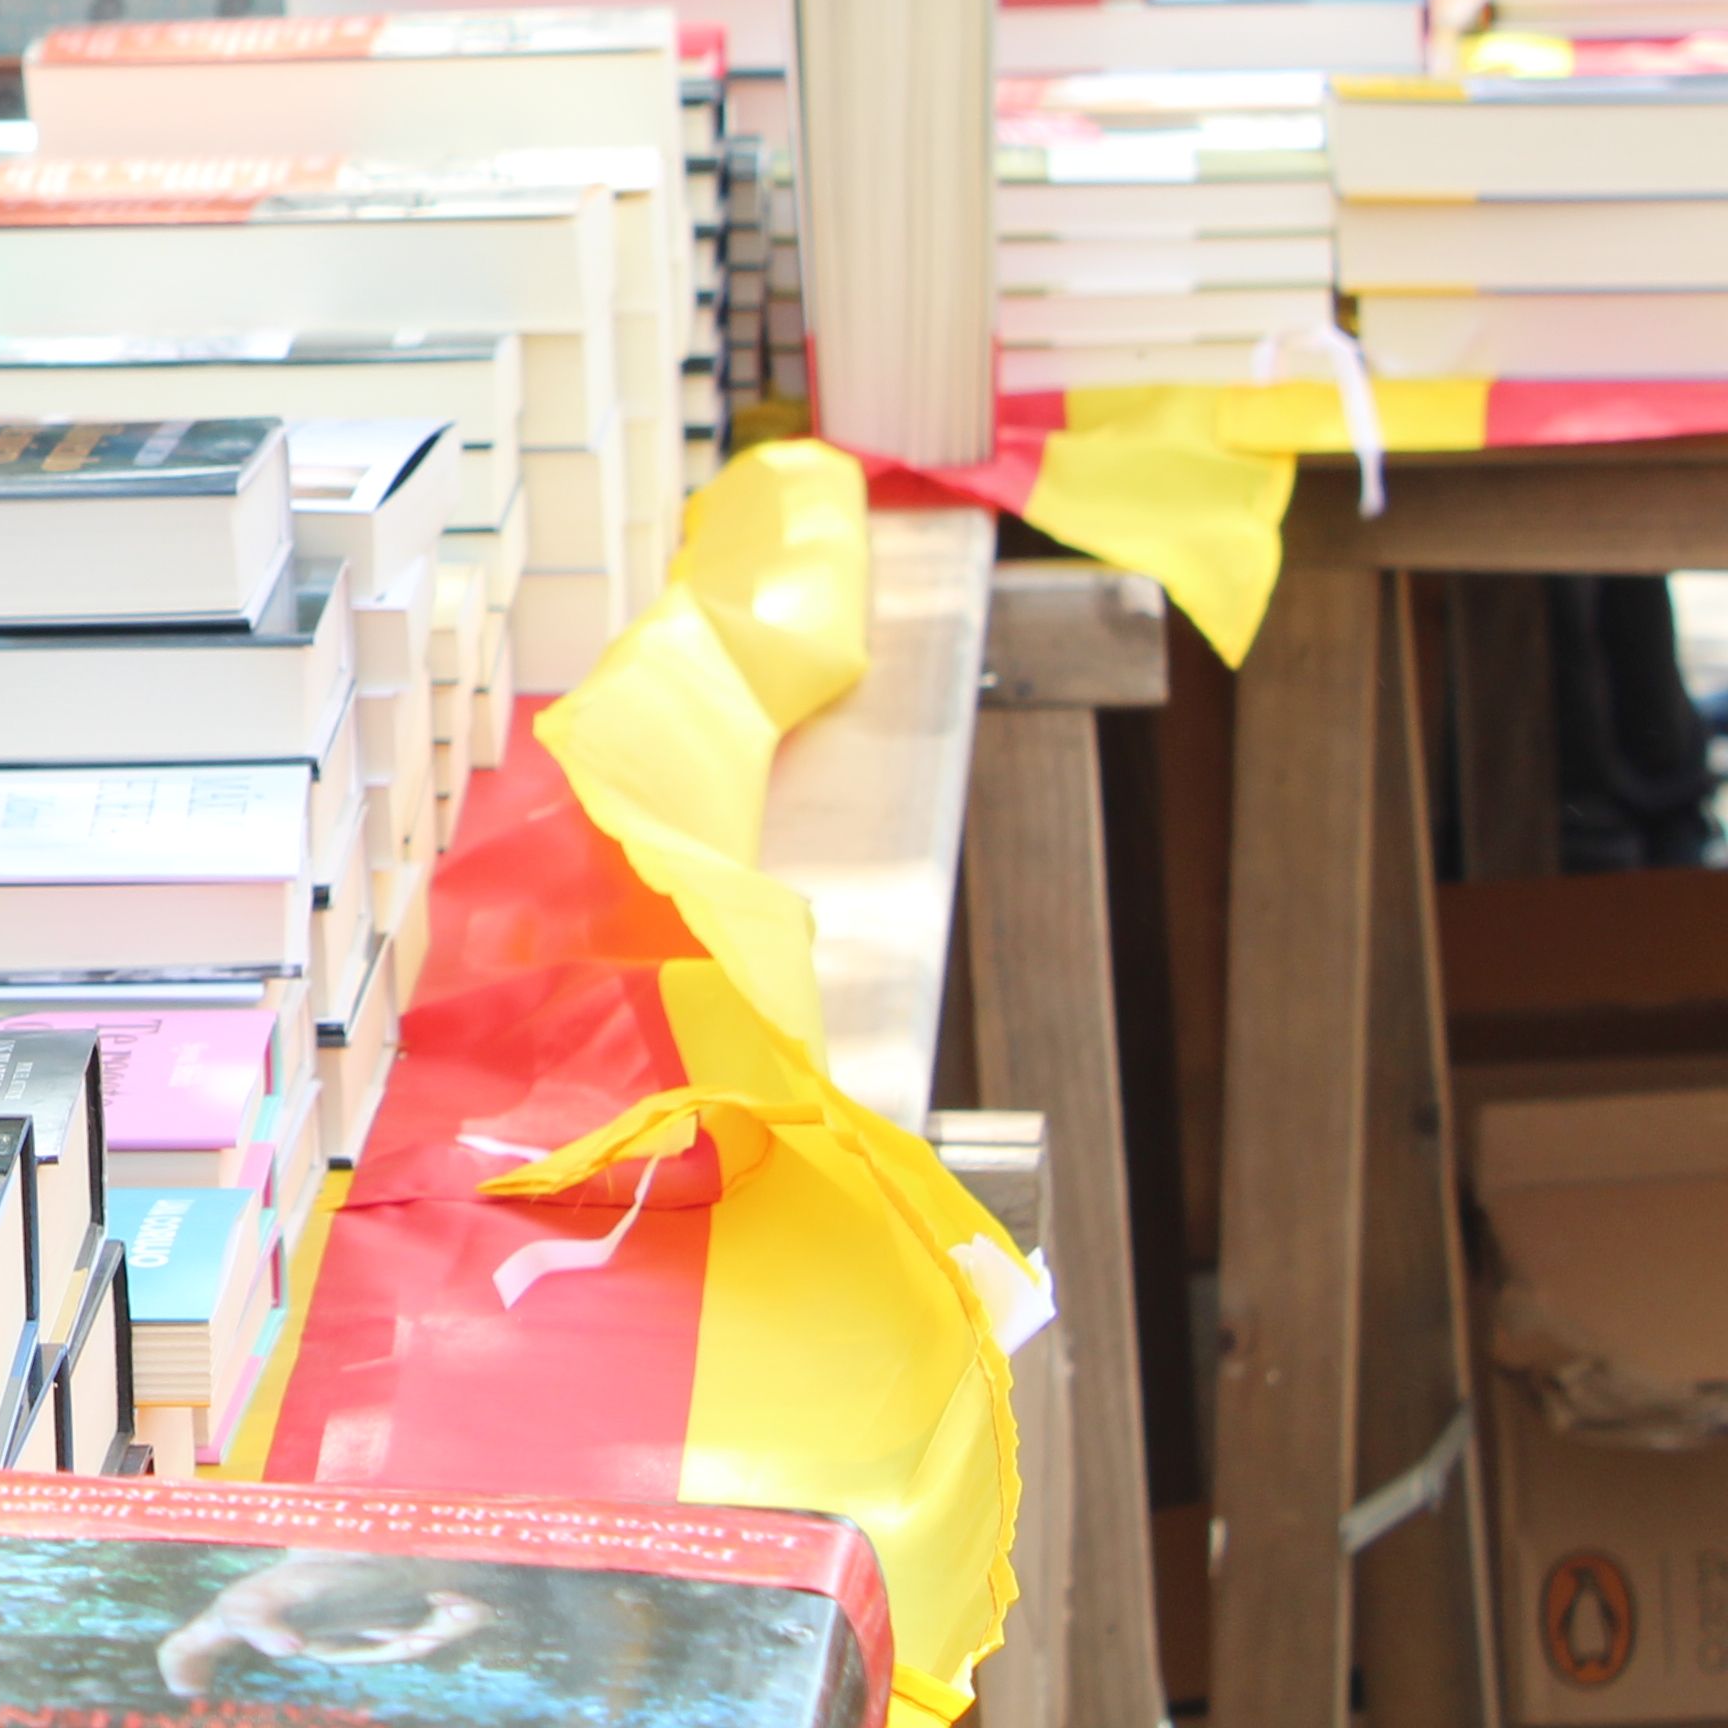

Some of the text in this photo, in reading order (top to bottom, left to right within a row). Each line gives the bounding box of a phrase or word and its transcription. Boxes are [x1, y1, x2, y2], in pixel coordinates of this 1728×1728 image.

[128, 1217, 183, 1268] CORUJO
[167, 1489, 348, 1513] Dolores
[247, 1509, 317, 1533] nit
[421, 1518, 504, 1542] per
[617, 1515, 730, 1542] nova
[741, 1527, 804, 1550] La
